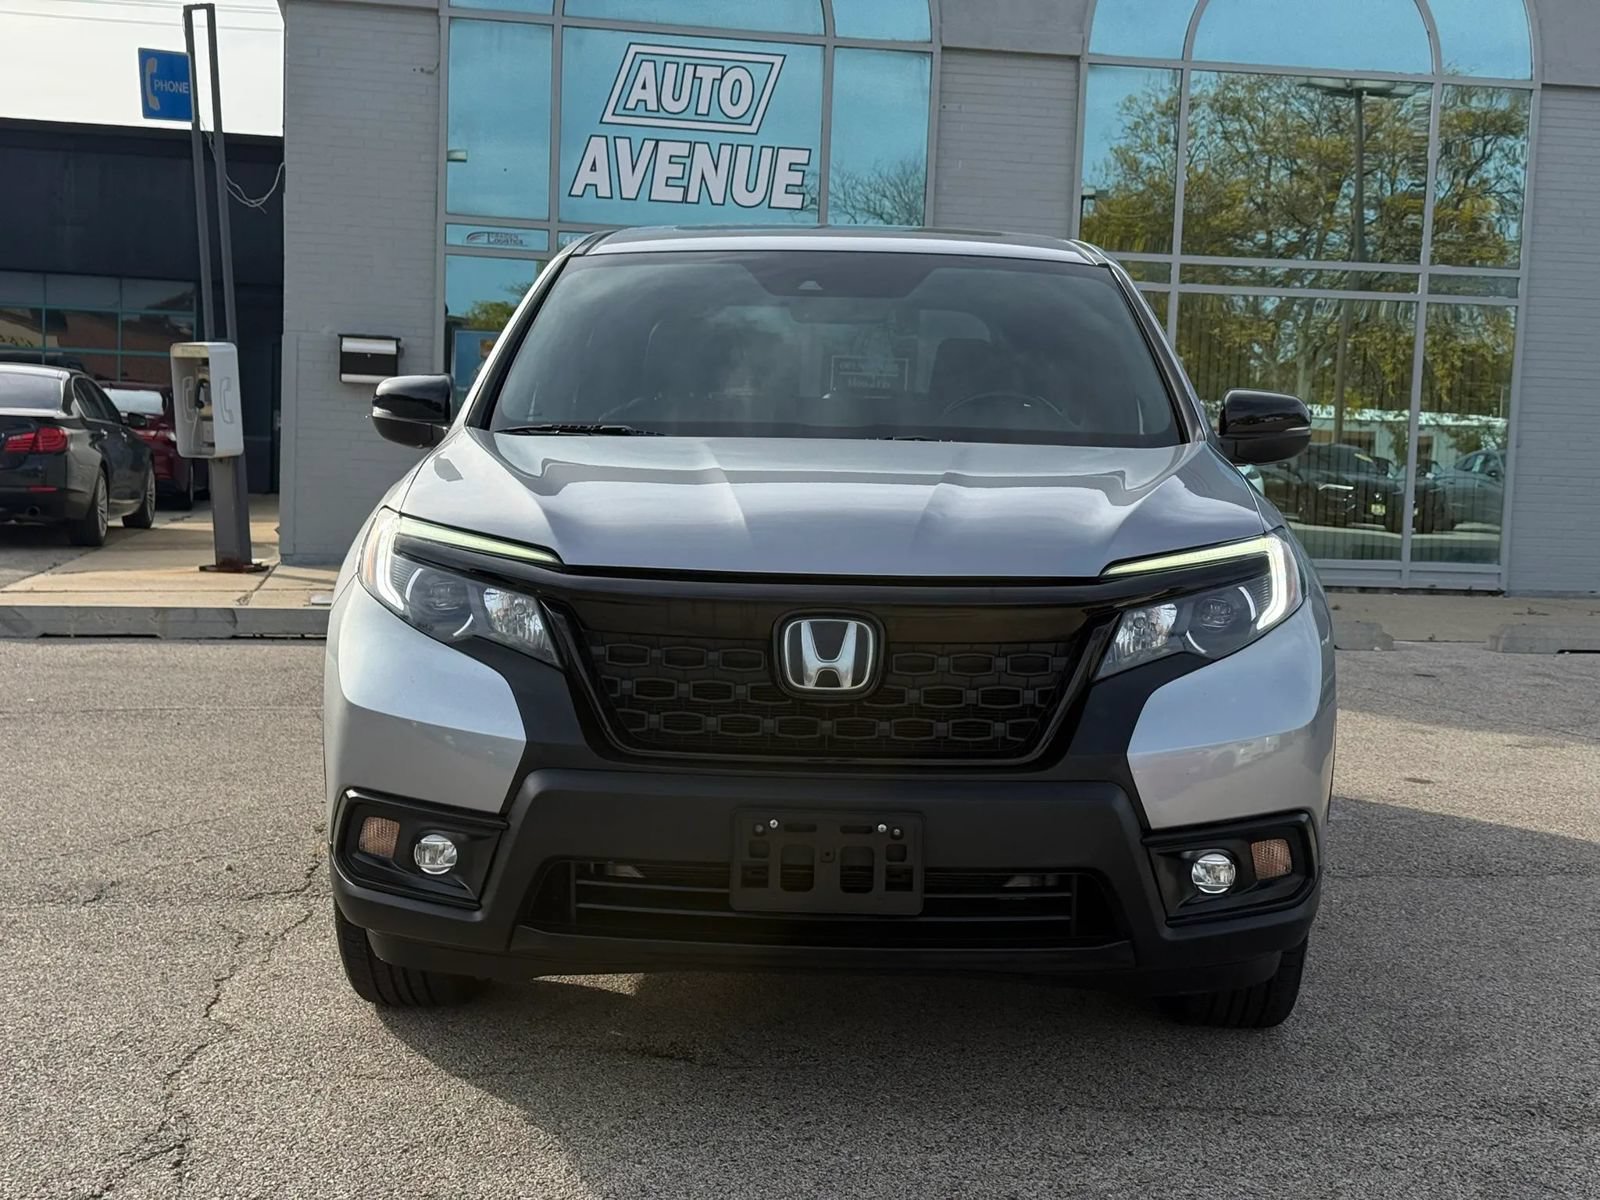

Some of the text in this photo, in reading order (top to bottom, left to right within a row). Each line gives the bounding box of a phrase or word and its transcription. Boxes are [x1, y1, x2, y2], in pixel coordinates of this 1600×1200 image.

[153, 79, 189, 94] PHONE
[623, 60, 754, 119] AUTO
[568, 135, 812, 210] AVENUE
